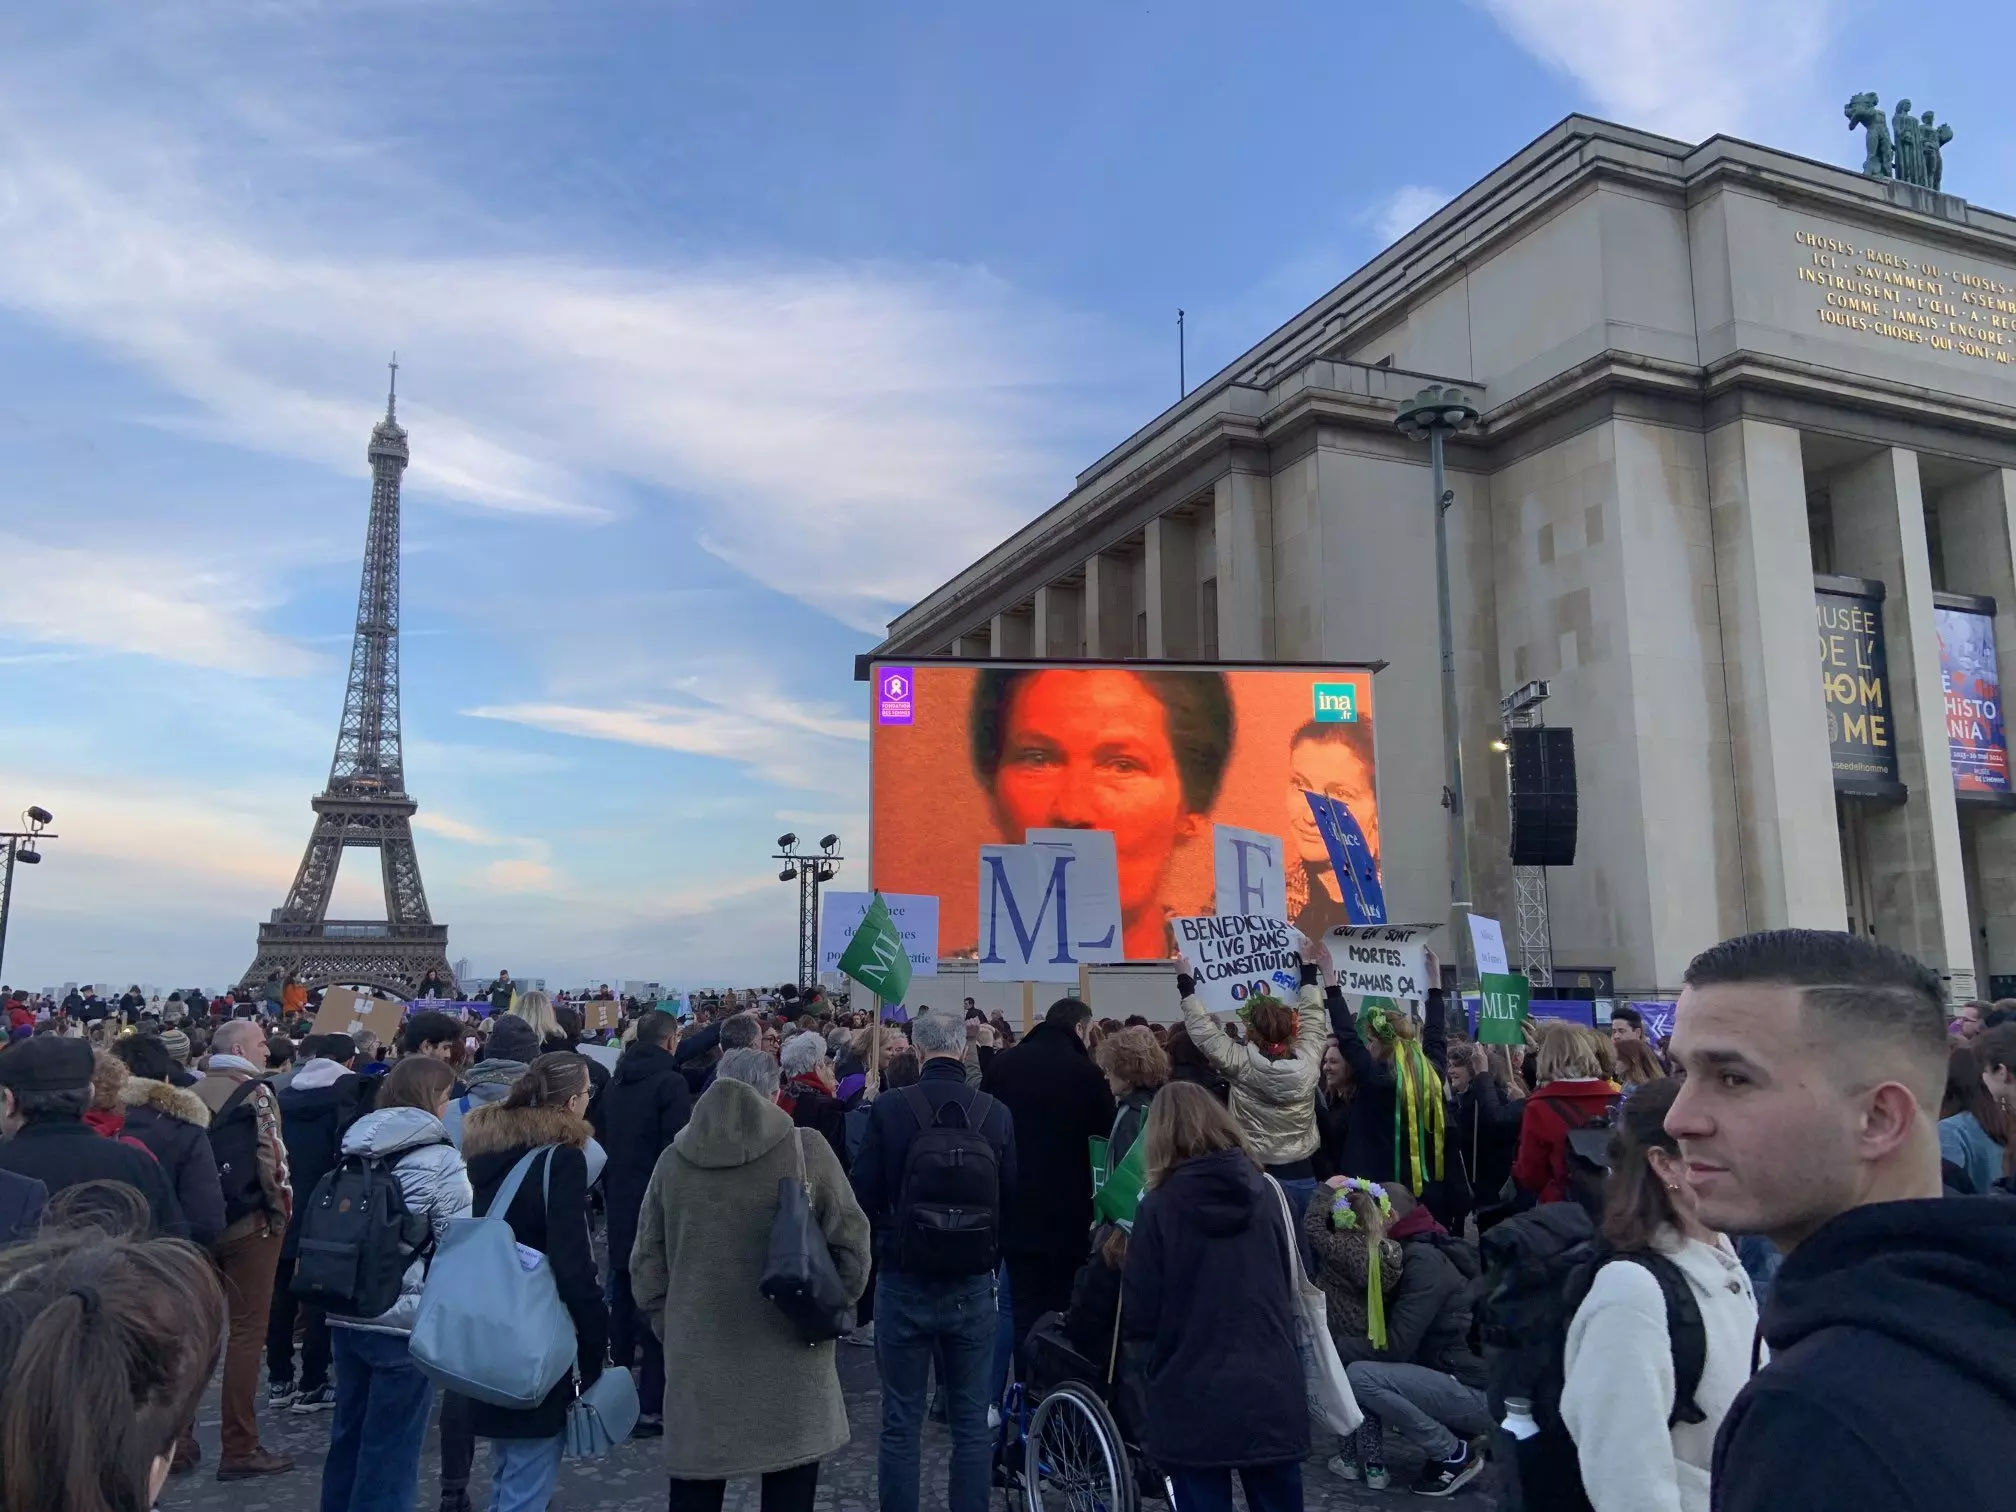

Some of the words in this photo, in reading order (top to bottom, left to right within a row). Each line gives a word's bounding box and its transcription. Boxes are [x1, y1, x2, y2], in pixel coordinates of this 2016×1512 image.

[1795, 231, 1854, 256] CHOSES
[1867, 249, 1909, 270] RARES
[1922, 263, 1940, 278] OU
[1952, 271, 2006, 294] CHOSES
[1813, 252, 1835, 269] ICI
[1856, 264, 1944, 296] SAVAMMENT
[1799, 267, 1901, 303] INSTRUISENT
[1817, 308, 1867, 331] TOUTES
[1874, 321, 1923, 344] CHOSES
[1931, 334, 1952, 351] QUI
[1958, 341, 1991, 360] SONT
[1996, 350, 2010, 364] AU
[1826, 292, 1880, 316] COMME
[1950, 322, 2005, 345] ENCORE
[1318, 691, 1352, 710] ina
[1843, 712, 1888, 747] ME
[1250, 930, 1290, 953] DANS
[1350, 972, 1393, 993] JAMAIS
[1482, 992, 1520, 1020] MLF
